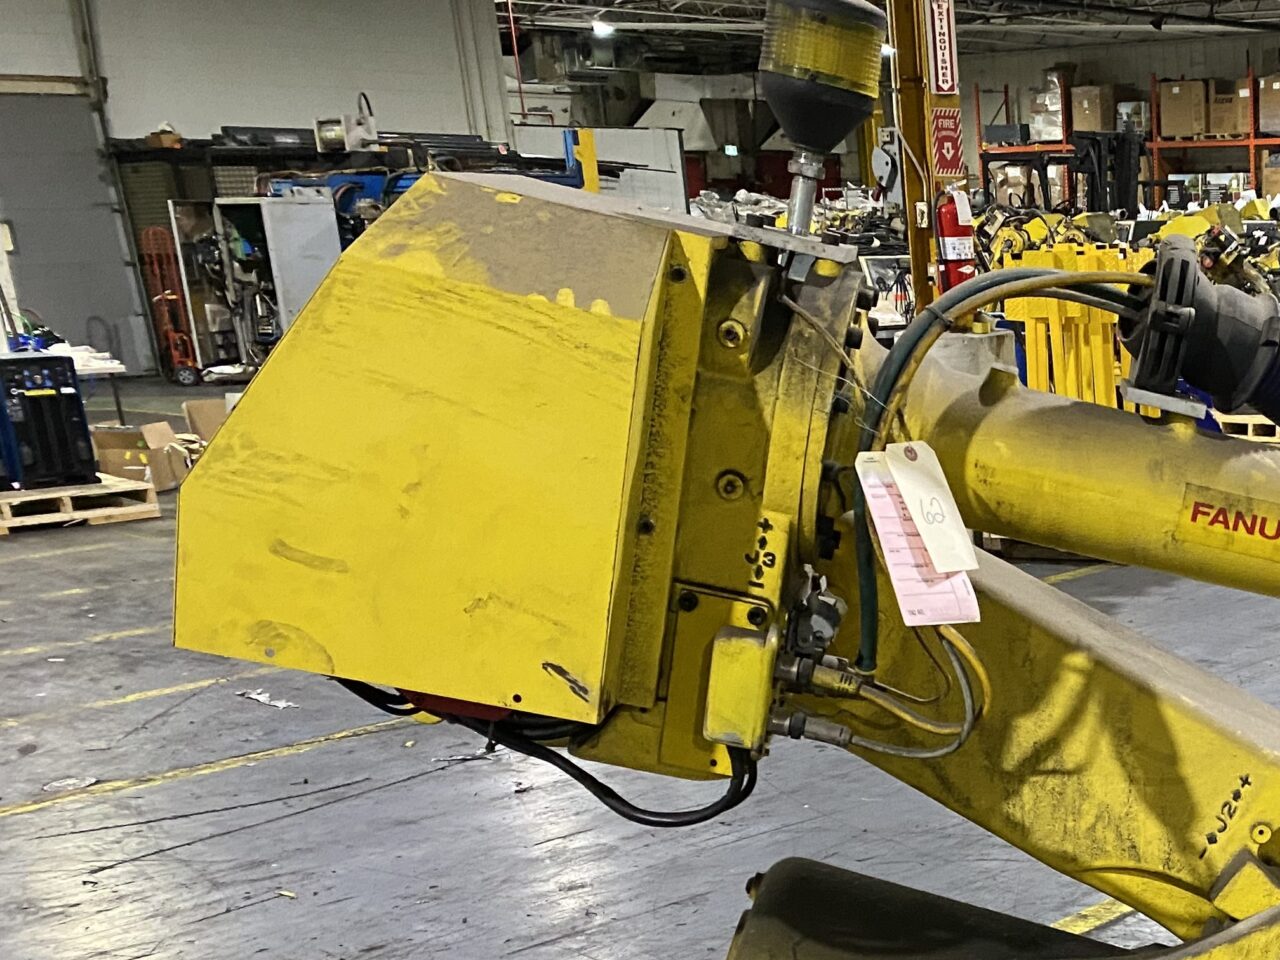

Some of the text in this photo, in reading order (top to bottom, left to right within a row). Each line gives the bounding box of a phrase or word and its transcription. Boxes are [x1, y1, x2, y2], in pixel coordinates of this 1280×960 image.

[937, 3, 949, 85] EXTINGUISHER
[938, 119, 955, 129] FIRE
[920, 496, 946, 525] 62
